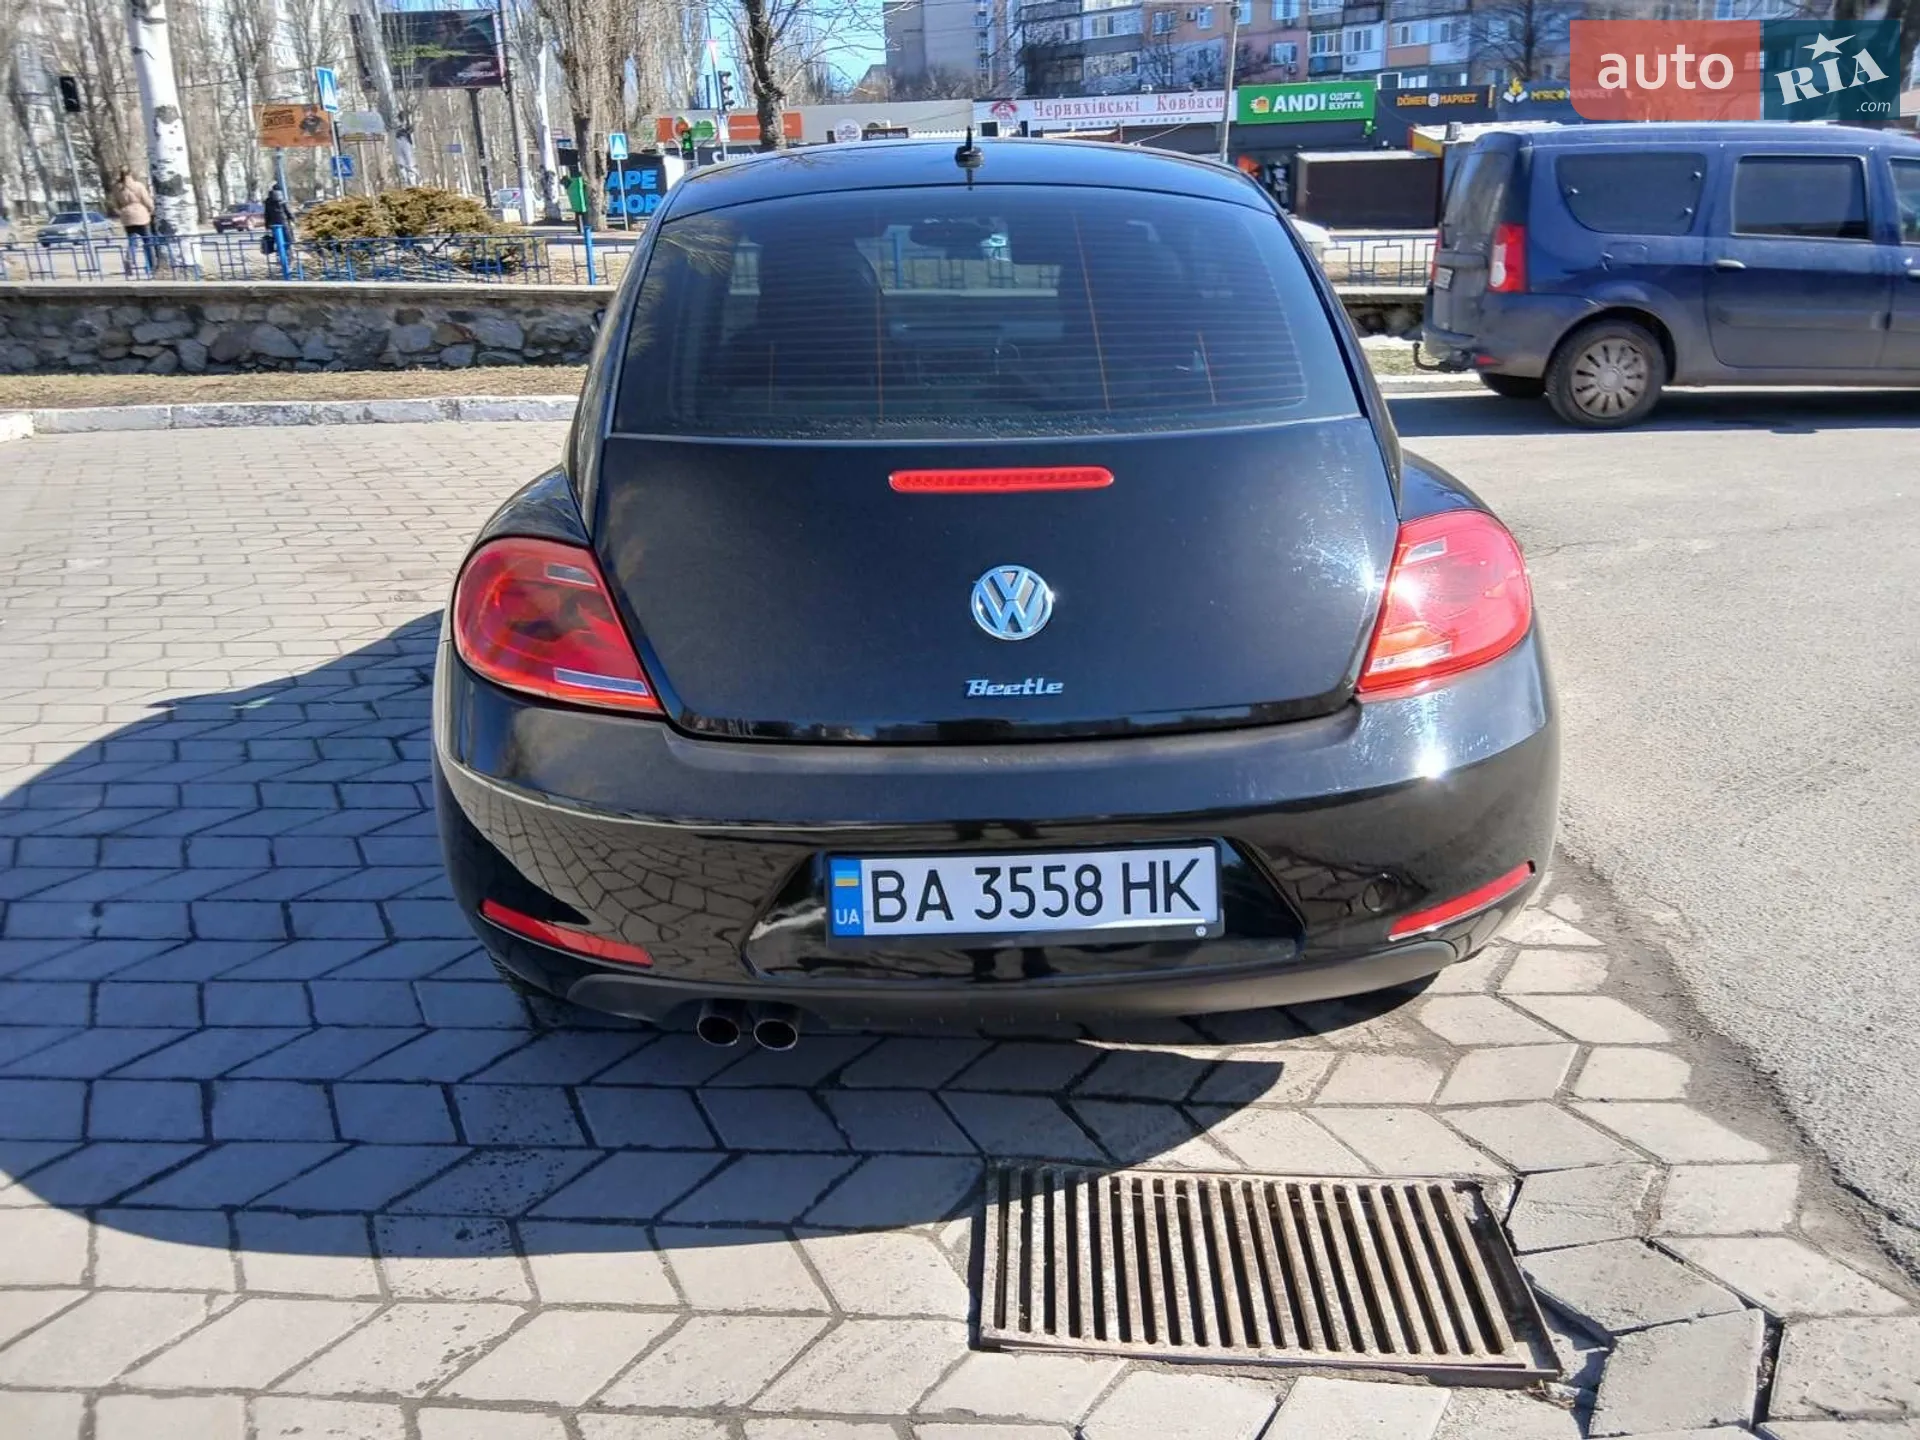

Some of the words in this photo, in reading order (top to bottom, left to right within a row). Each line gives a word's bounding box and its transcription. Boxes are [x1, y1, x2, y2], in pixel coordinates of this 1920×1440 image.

[1034, 95, 1140, 118] Черняхівські
[1156, 94, 1224, 112] Ковбаси
[1273, 93, 1326, 113] ANDI
[965, 678, 1064, 697] Beetle
[870, 868, 954, 923] BA
[974, 863, 1103, 920] 3558
[1121, 858, 1200, 915] HK
[835, 908, 861, 925] UA
